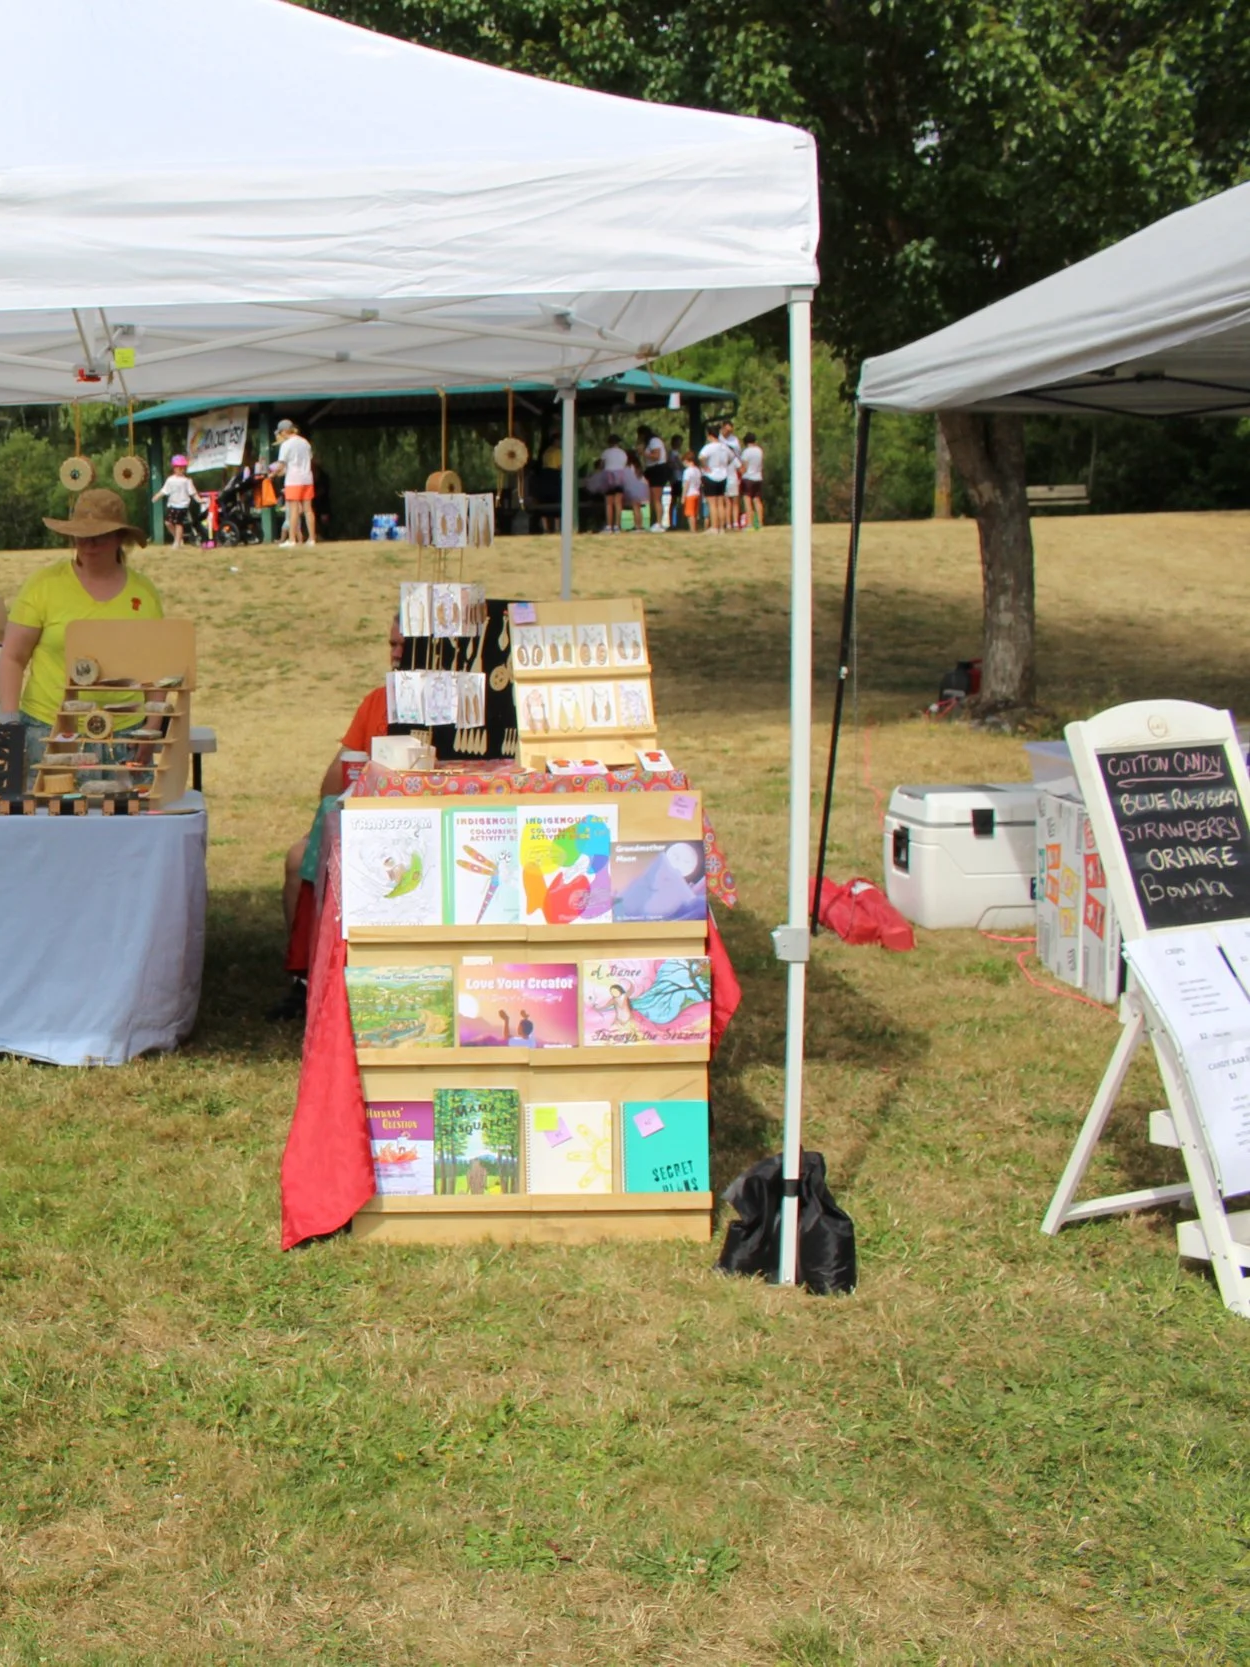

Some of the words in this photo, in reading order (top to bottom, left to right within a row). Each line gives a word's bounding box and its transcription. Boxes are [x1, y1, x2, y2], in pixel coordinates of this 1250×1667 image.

[1107, 754, 1169, 776] COTTON
[1173, 751, 1222, 776] CANDY
[1120, 793, 1169, 816] BLUE
[1121, 816, 1241, 842] STRAWBERRY
[1148, 846, 1239, 871] ORANGE
[606, 964, 642, 978] Dance
[465, 978, 495, 990] Love
[497, 977, 525, 990] Your
[527, 976, 574, 989] Creator
[652, 1159, 694, 1182] SECRET
